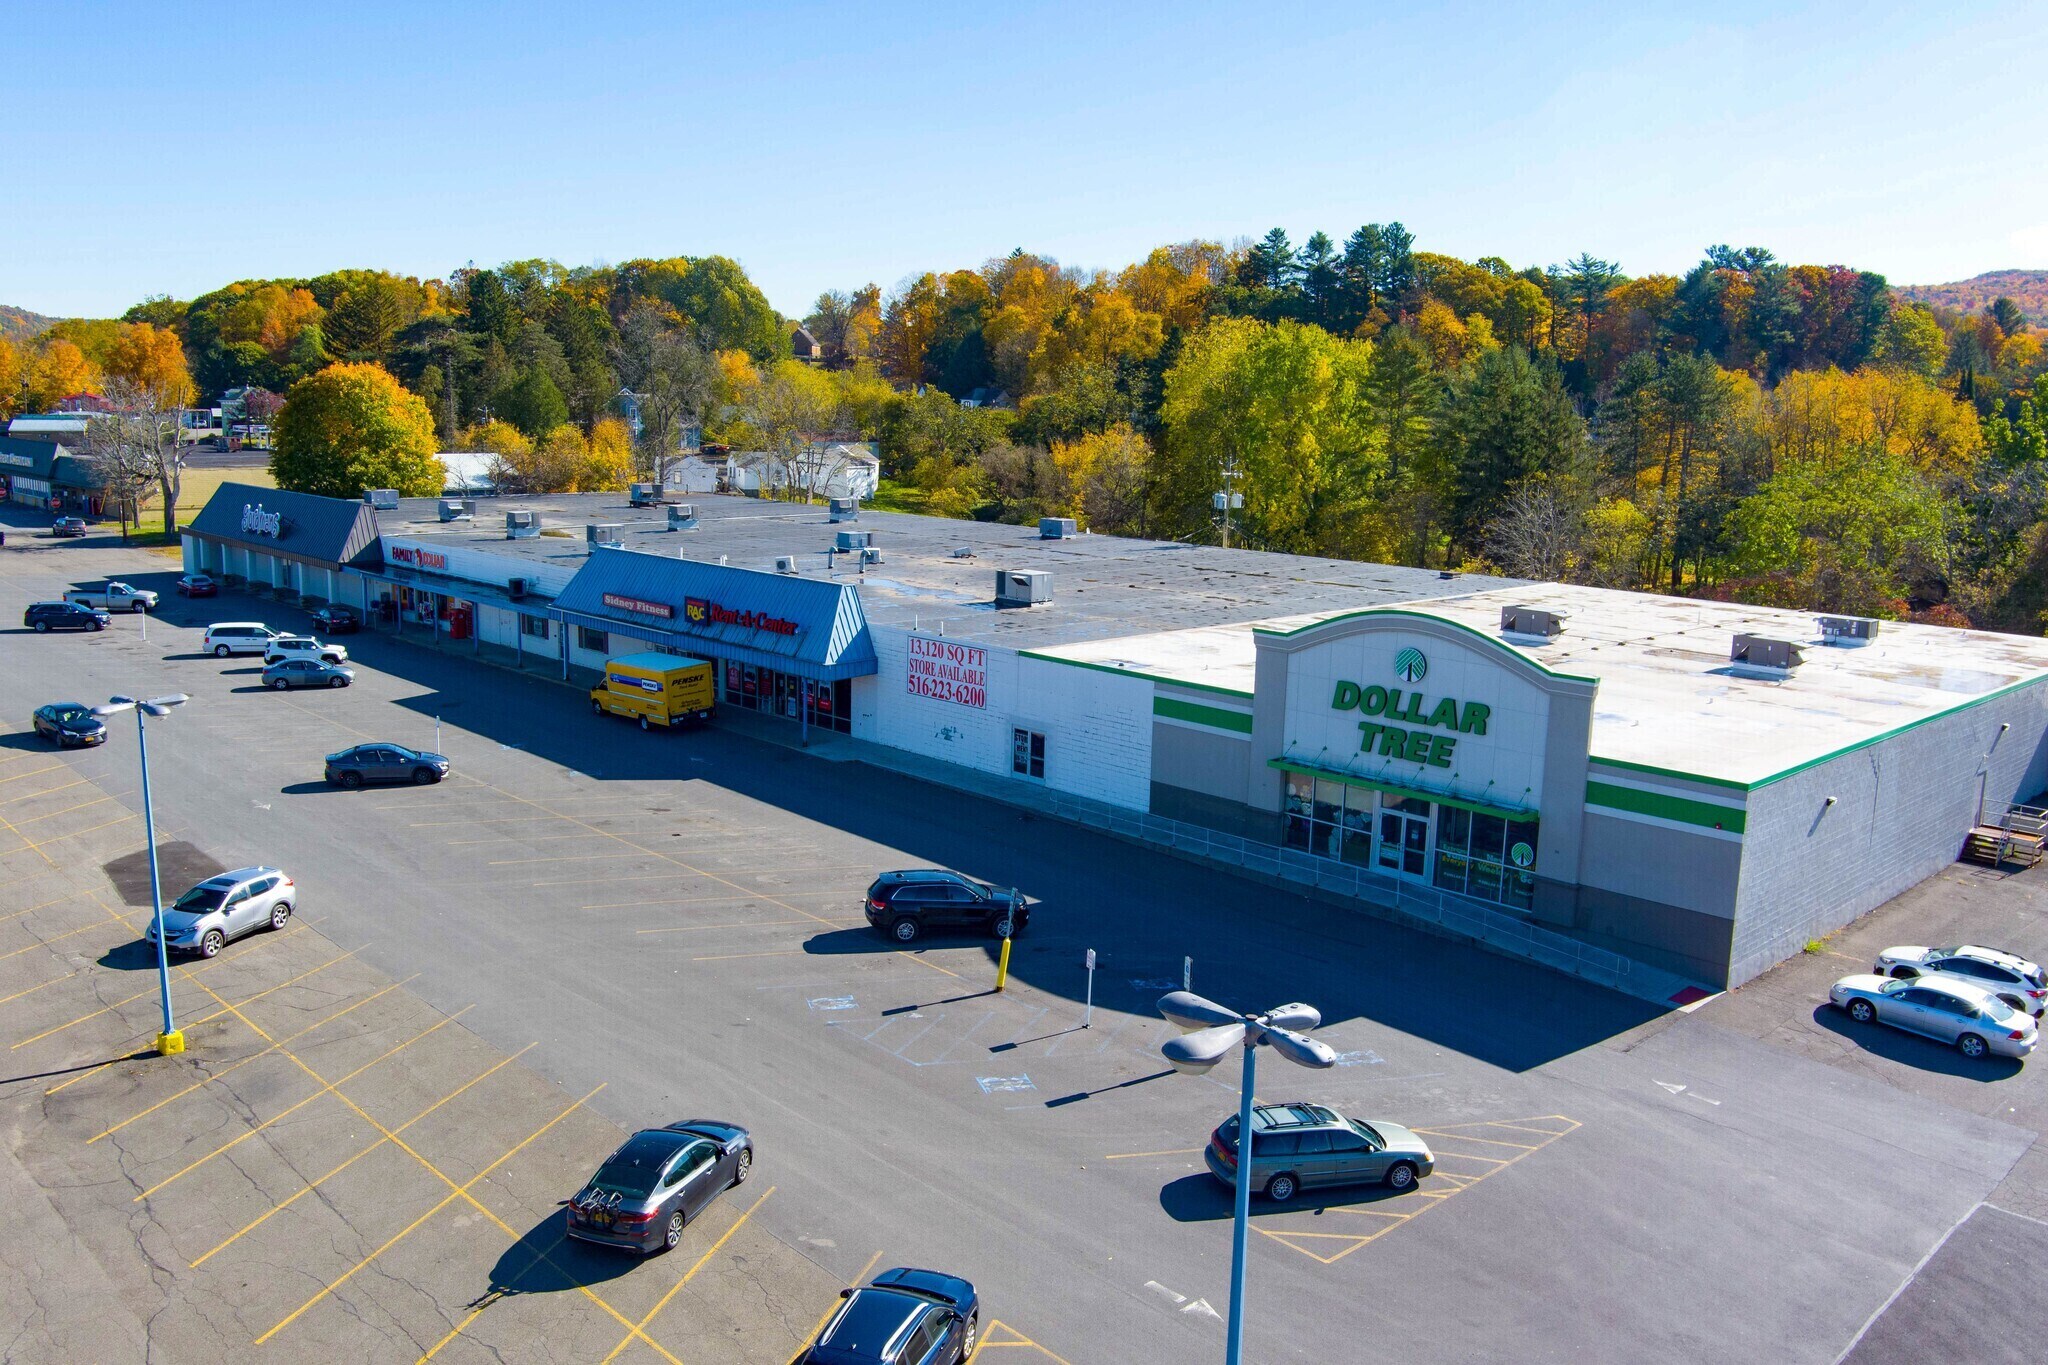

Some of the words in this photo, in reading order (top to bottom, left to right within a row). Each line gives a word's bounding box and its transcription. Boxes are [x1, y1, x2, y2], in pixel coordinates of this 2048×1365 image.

[392, 546, 414, 563] FAMILY
[423, 551, 445, 570] DOLLAR
[604, 595, 634, 610] Sidney
[636, 601, 670, 616] Fitness
[687, 604, 705, 621] RAC
[910, 638, 944, 659] 13,120
[947, 644, 965, 667] SQ
[968, 648, 986, 667] FT
[671, 674, 705, 687] PENSKE
[909, 657, 936, 677] STORE
[937, 663, 985, 687] AVAILABLE
[908, 674, 985, 708] 516-223-6200
[1331, 680, 1490, 736] DOLLAR
[1358, 721, 1457, 768] TREE
